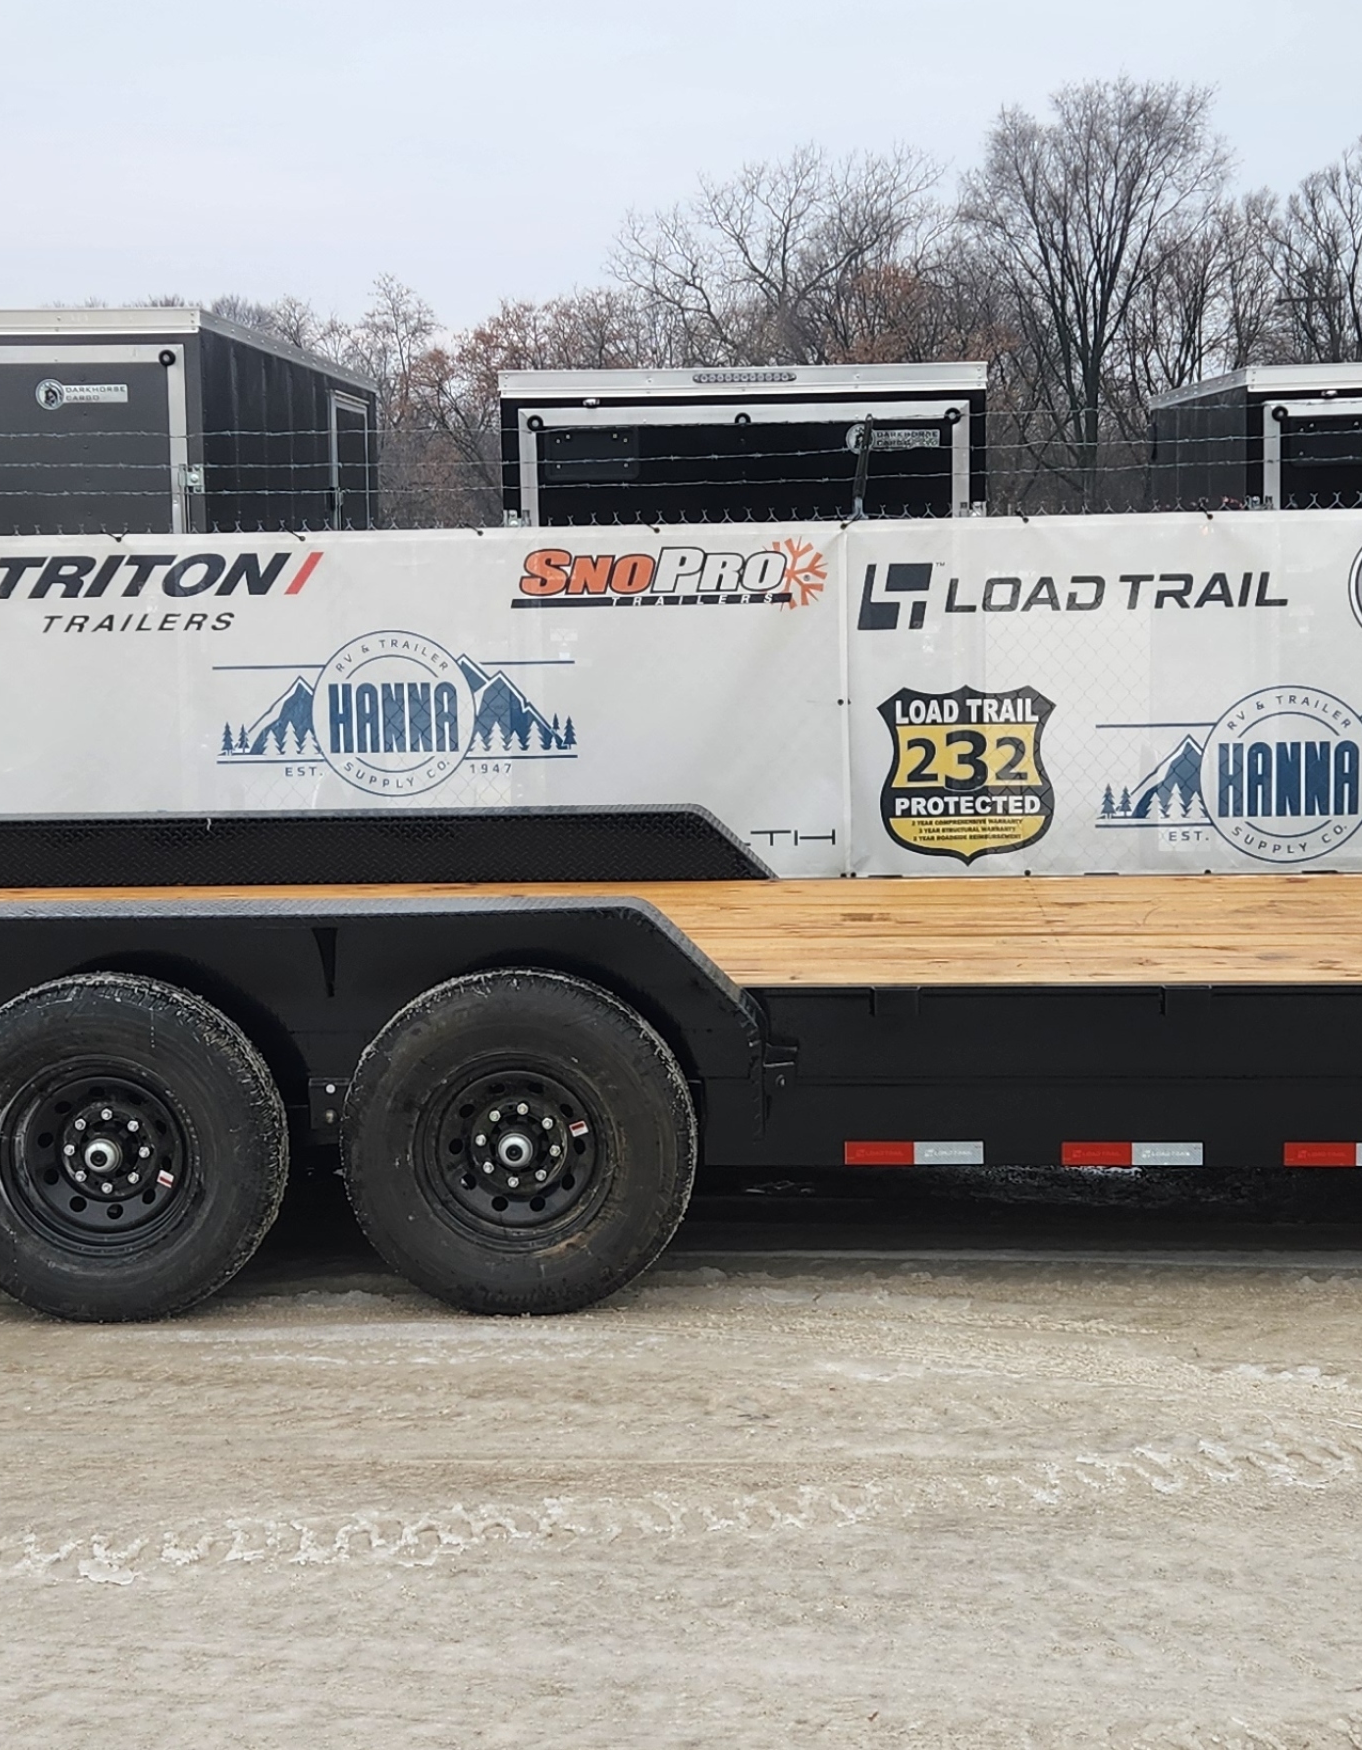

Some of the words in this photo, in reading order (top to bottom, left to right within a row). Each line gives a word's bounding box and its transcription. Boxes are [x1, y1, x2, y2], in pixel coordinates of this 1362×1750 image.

[611, 593, 774, 607] TRAILERS
[945, 575, 1106, 613] LOAD
[1119, 571, 1289, 609] TRAIL
[42, 611, 235, 635] TRAILERS
[335, 653, 355, 672] RV
[361, 644, 371, 654] &
[379, 638, 449, 671] TRAILER
[328, 681, 460, 754] HANNA
[895, 698, 959, 725] LOAD
[966, 697, 1040, 724] TRAIL
[1226, 710, 1246, 732] RV
[1255, 700, 1265, 711] &
[1275, 694, 1352, 729] TRAILER
[285, 766, 324, 777] EST.
[469, 763, 513, 774] 1947
[343, 761, 416, 789] SUPPLY
[427, 759, 451, 779] CO.
[906, 729, 1028, 792] 232
[1218, 739, 1360, 818] HANNA
[895, 795, 1042, 817] PROTECTED
[1168, 830, 1210, 842] EST.
[1230, 826, 1308, 854] SUPPLY
[1322, 822, 1348, 845] CO.
